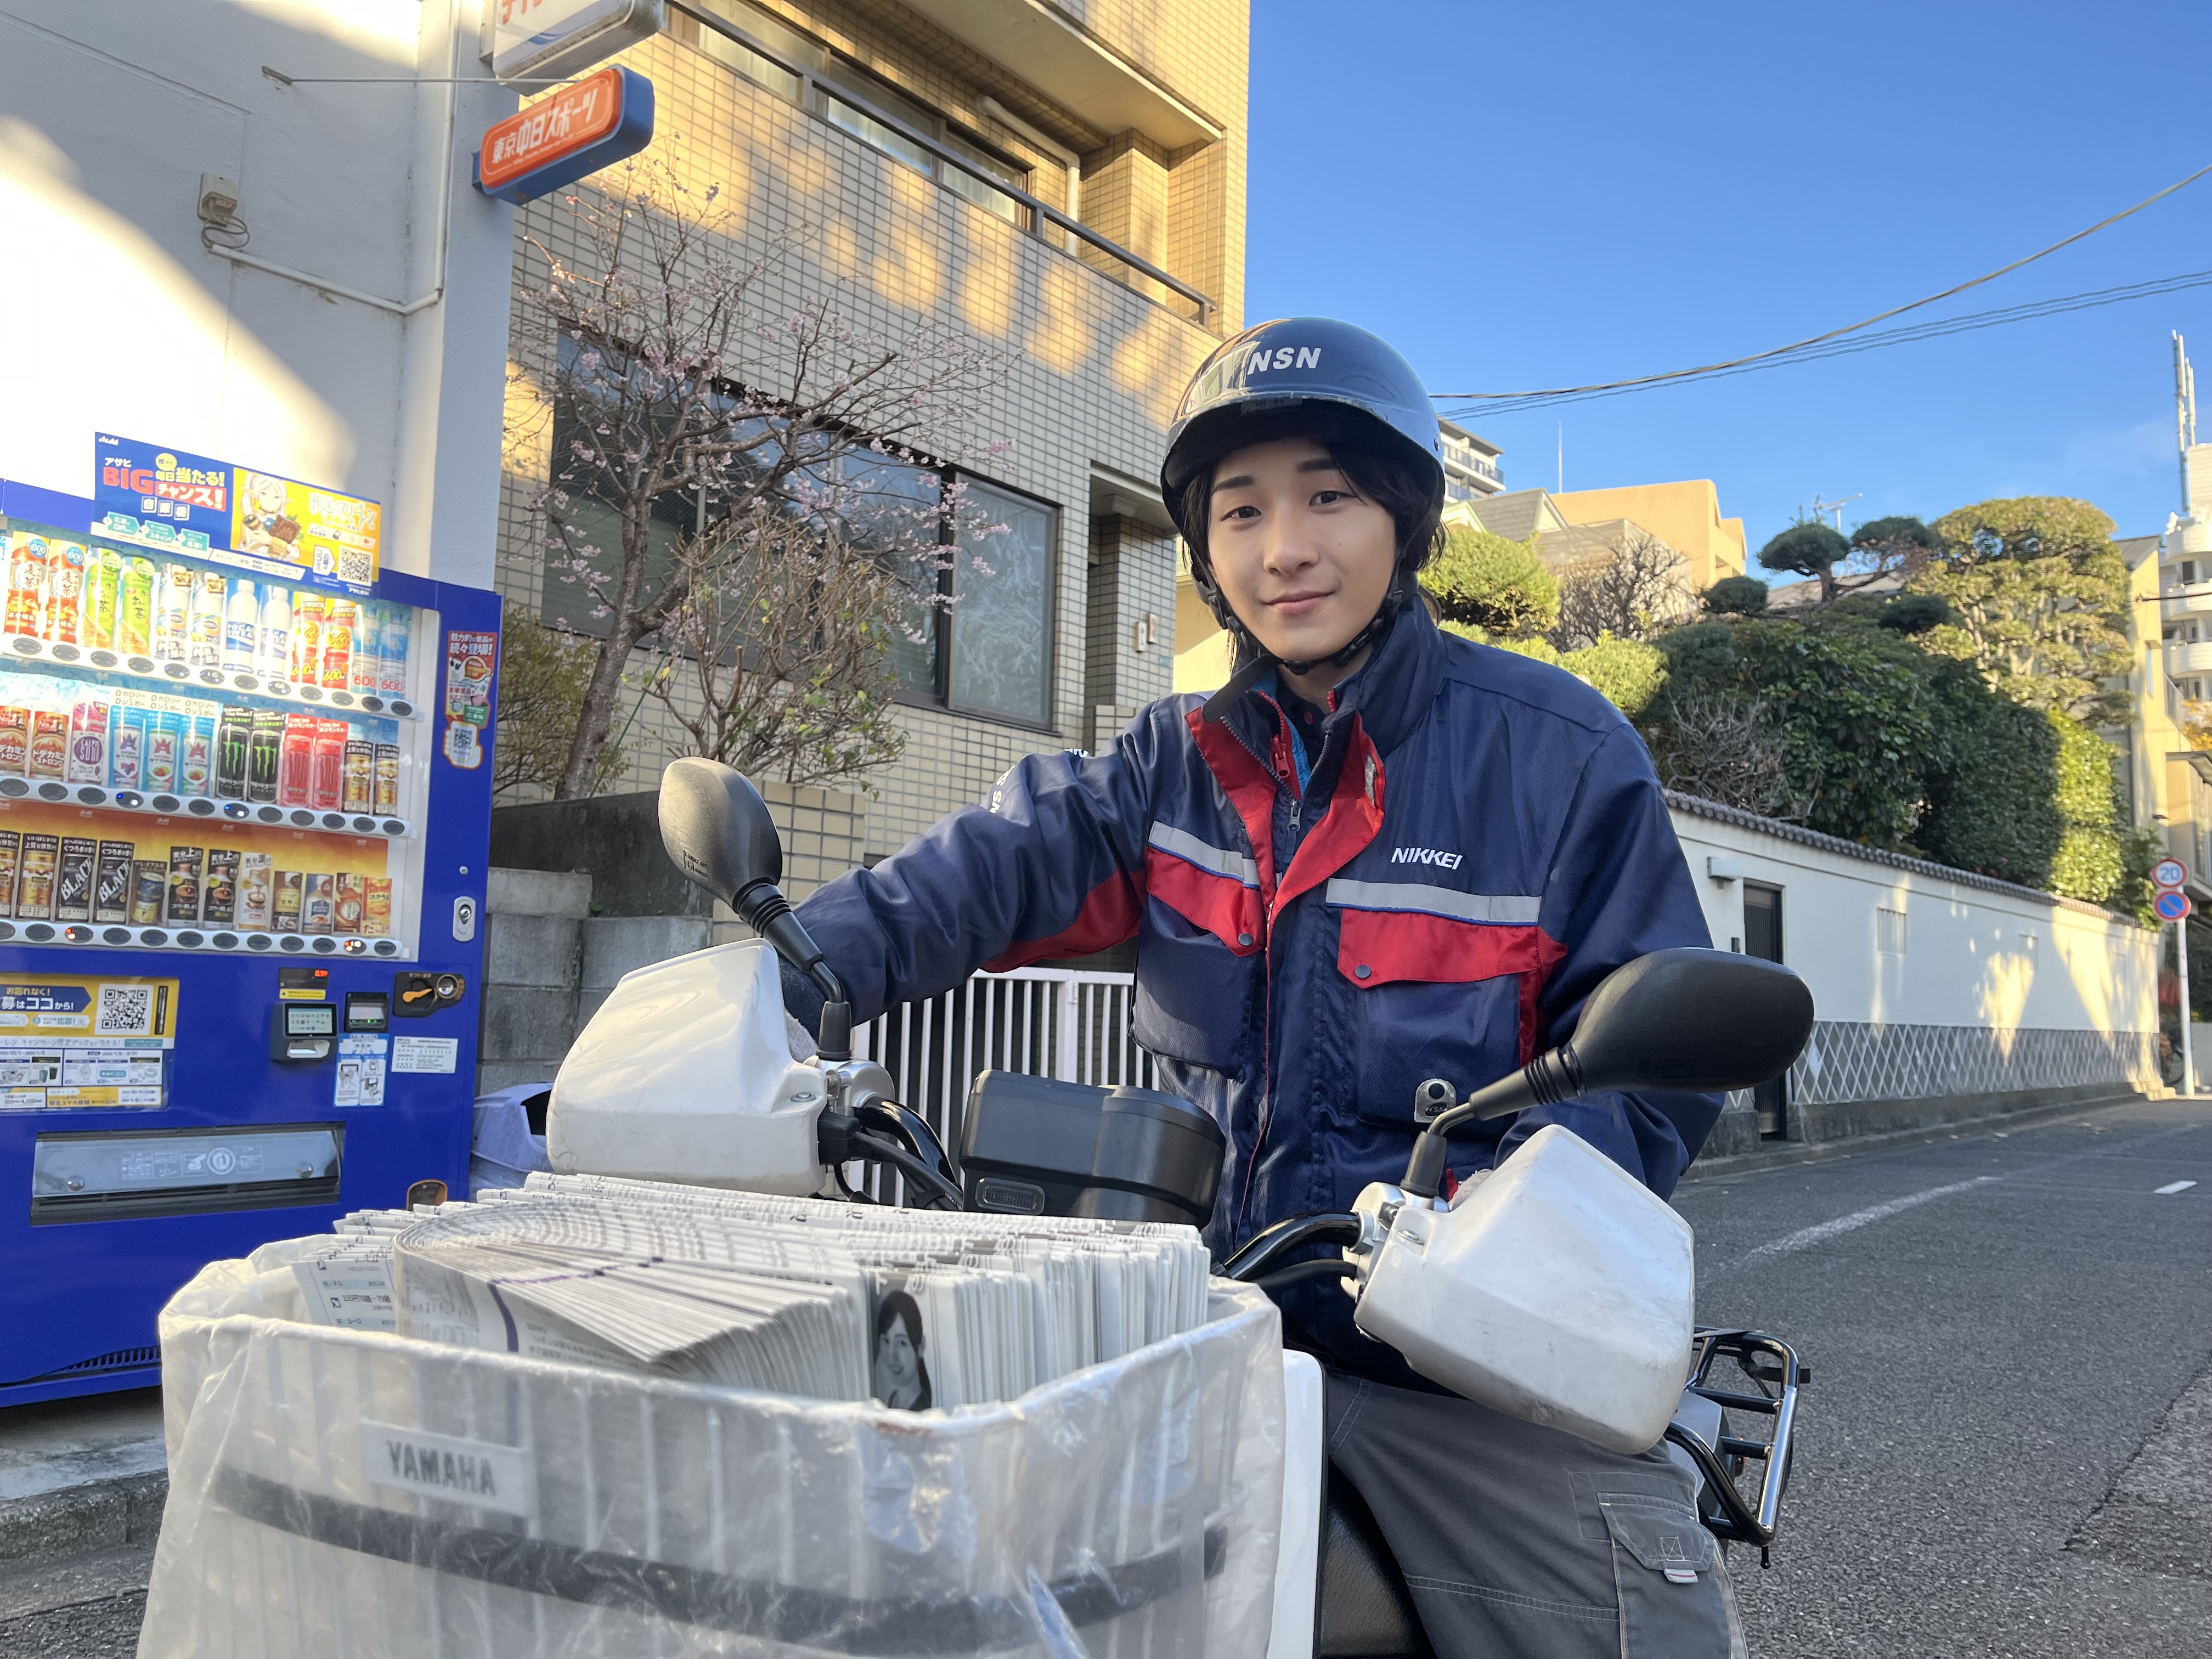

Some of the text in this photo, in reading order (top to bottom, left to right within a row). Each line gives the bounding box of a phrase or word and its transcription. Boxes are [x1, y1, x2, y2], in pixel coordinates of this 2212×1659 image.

[492, 89, 597, 163] 東京中日スポーツ
[1247, 347, 1322, 375] NSN
[105, 457, 132, 467] アサヒ
[103, 467, 154, 495] BIG
[157, 483, 223, 509] チャンス!
[30, 544, 46, 553] 600
[67, 552, 82, 561] 600
[324, 670, 342, 681] 600
[354, 675, 376, 688] 600
[381, 680, 404, 692] 600
[1391, 848, 1463, 870] NIKKEI
[2160, 866, 2180, 881] 20
[6, 988, 50, 996] お忘れなく!
[0, 997, 74, 1011] 募はココから!
[386, 1440, 496, 1496] YAMAHA
